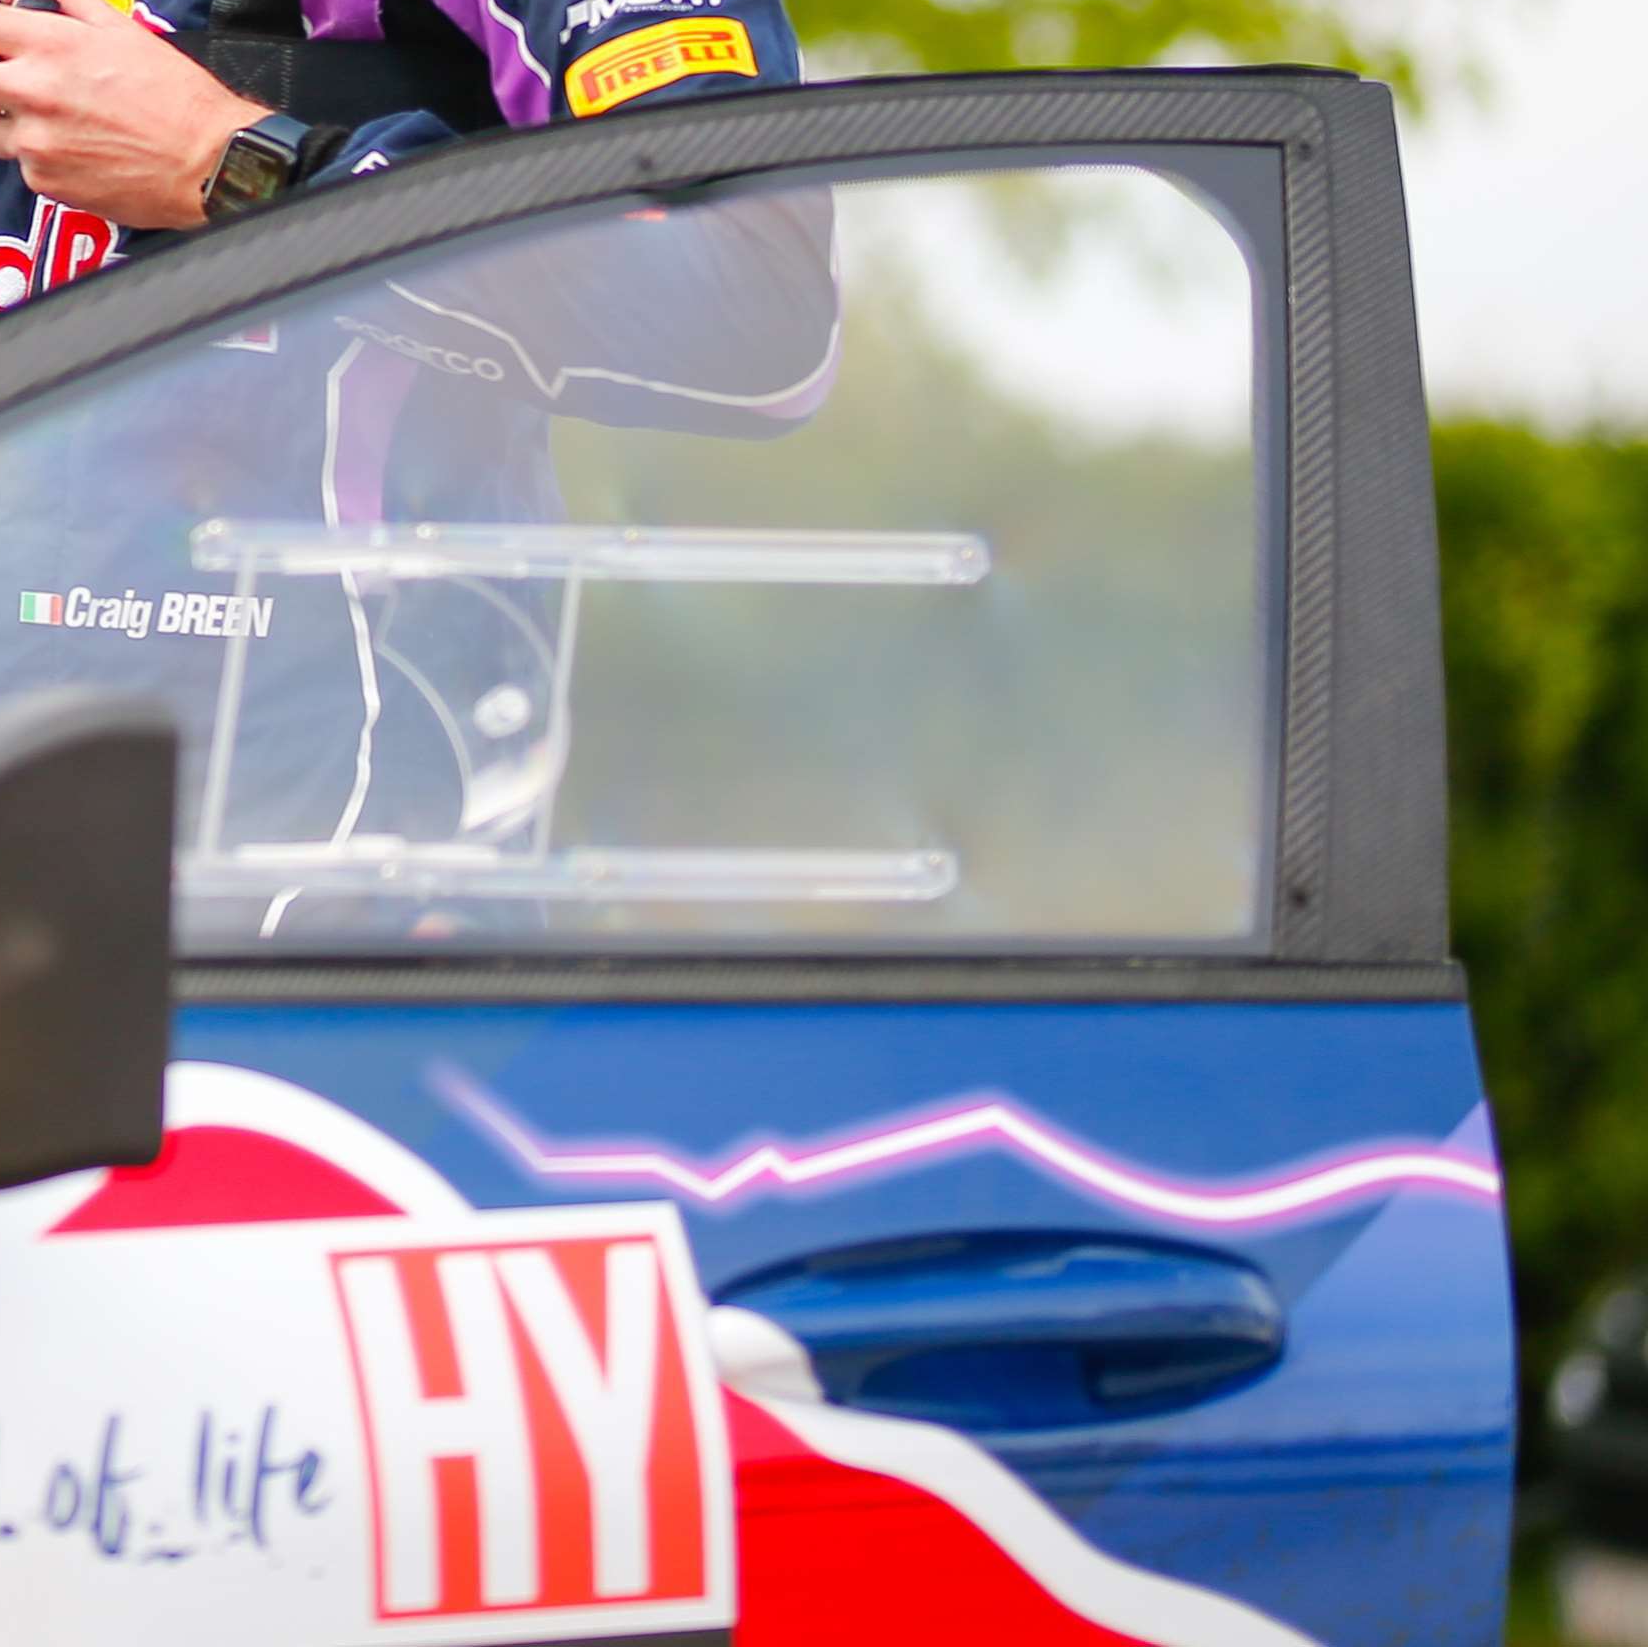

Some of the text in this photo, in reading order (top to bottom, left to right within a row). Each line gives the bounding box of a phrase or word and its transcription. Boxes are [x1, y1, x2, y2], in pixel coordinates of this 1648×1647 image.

[579, 32, 740, 103] PIRELLI
[64, 587, 273, 638] Craig BREEN
[43, 1416, 140, 1558] of
[193, 1404, 335, 1550] life
[339, 1250, 671, 1610] HY
